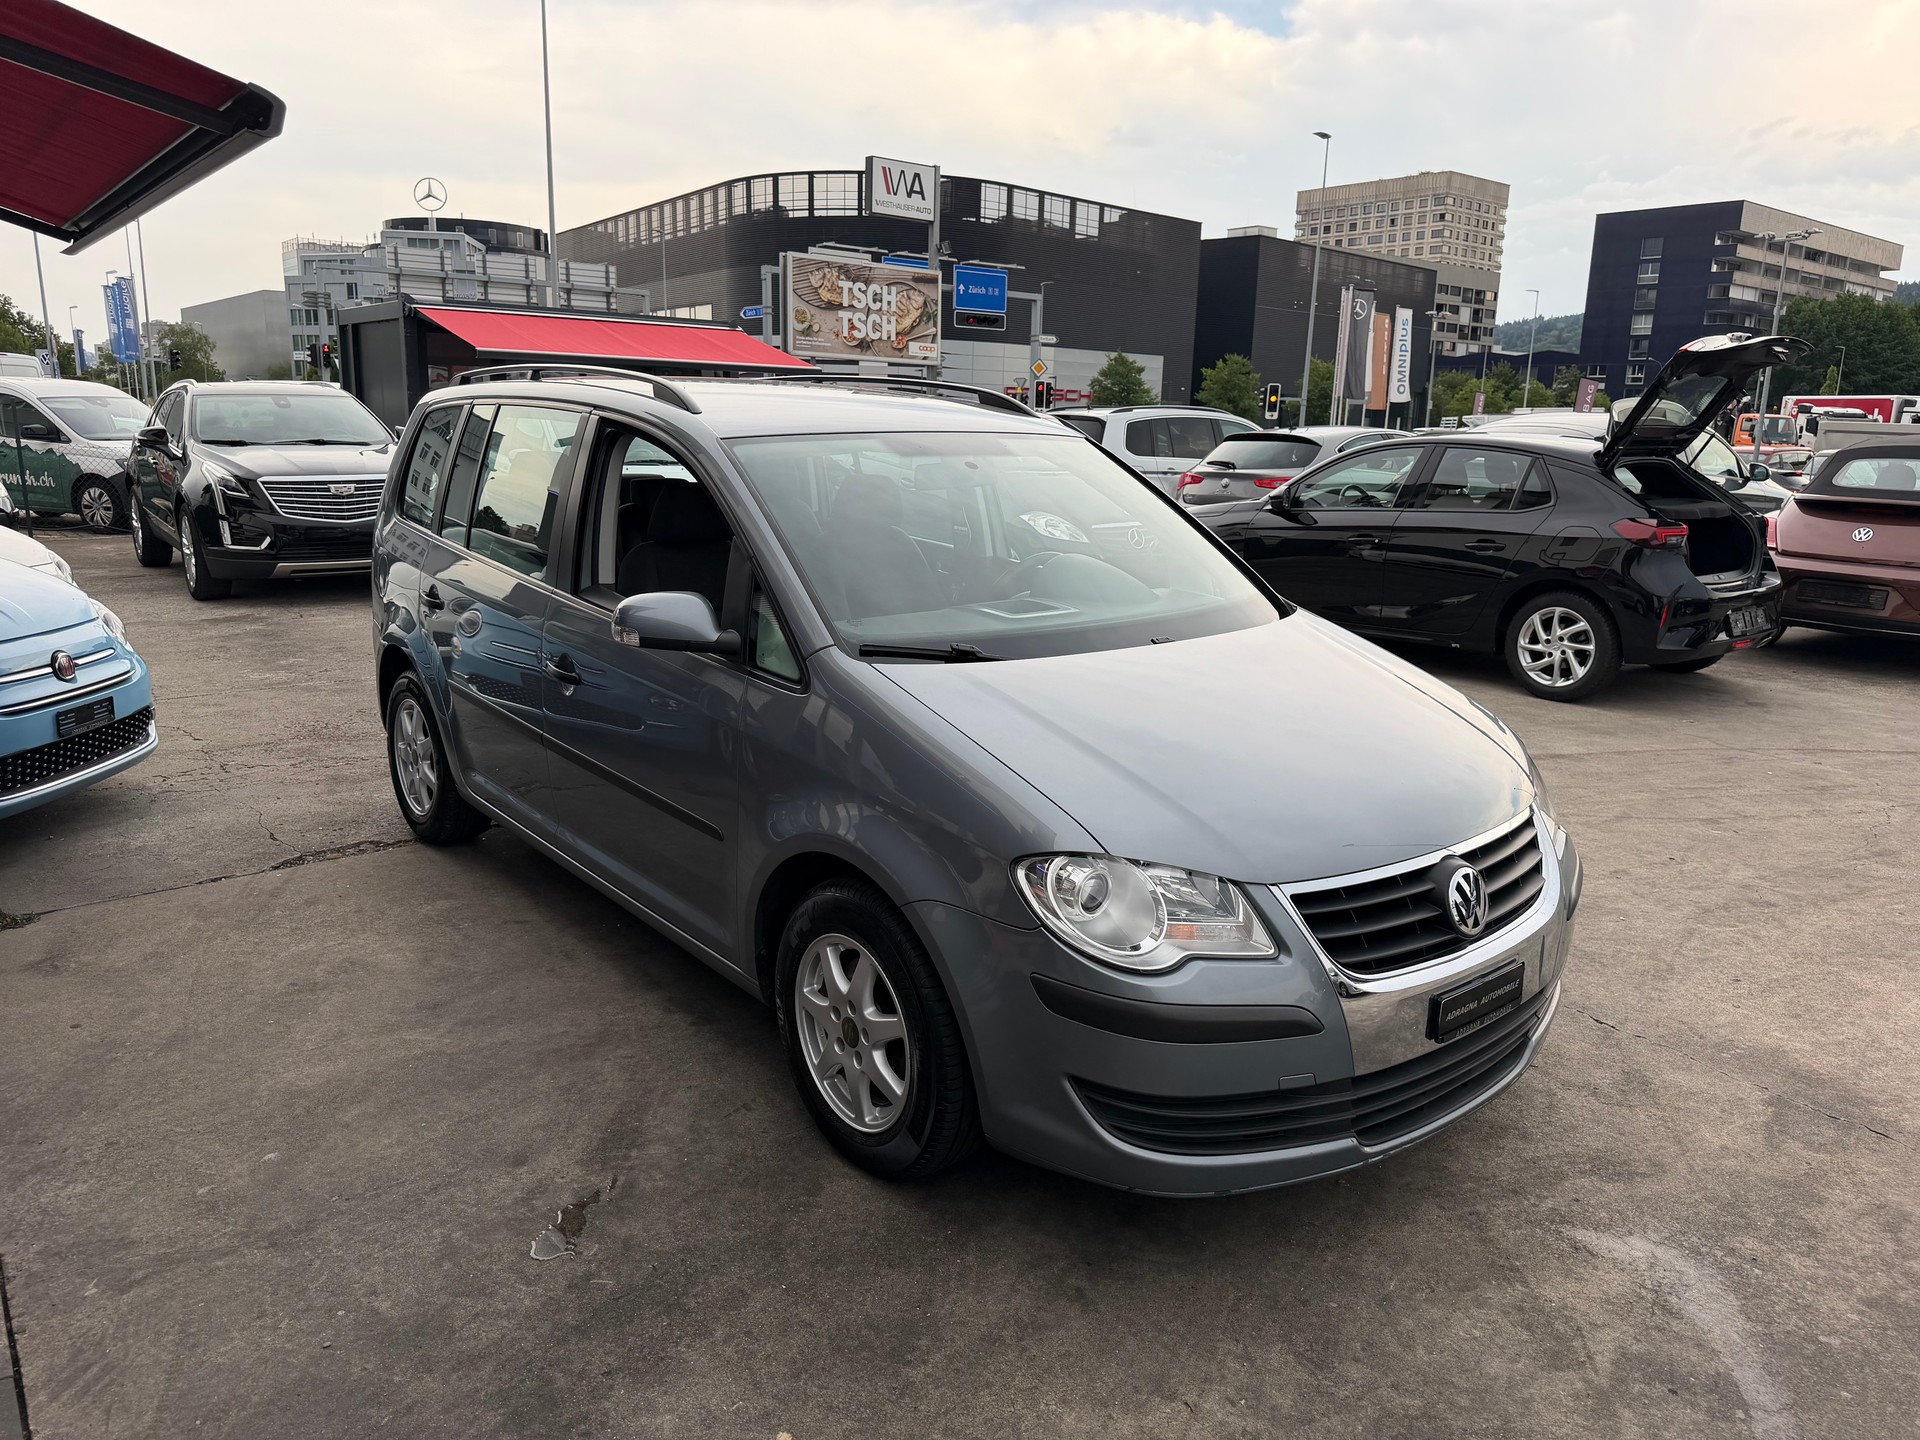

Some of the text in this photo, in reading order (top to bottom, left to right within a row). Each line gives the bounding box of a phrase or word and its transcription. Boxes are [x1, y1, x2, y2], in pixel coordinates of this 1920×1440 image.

[839, 281, 897, 312] TSCH
[968, 285, 986, 295] Zürich
[838, 310, 897, 341] TSCH
[1397, 318, 1409, 394] OMNIplus
[1446, 979, 1520, 1022] ADRAGNA AUTOMOBILE
